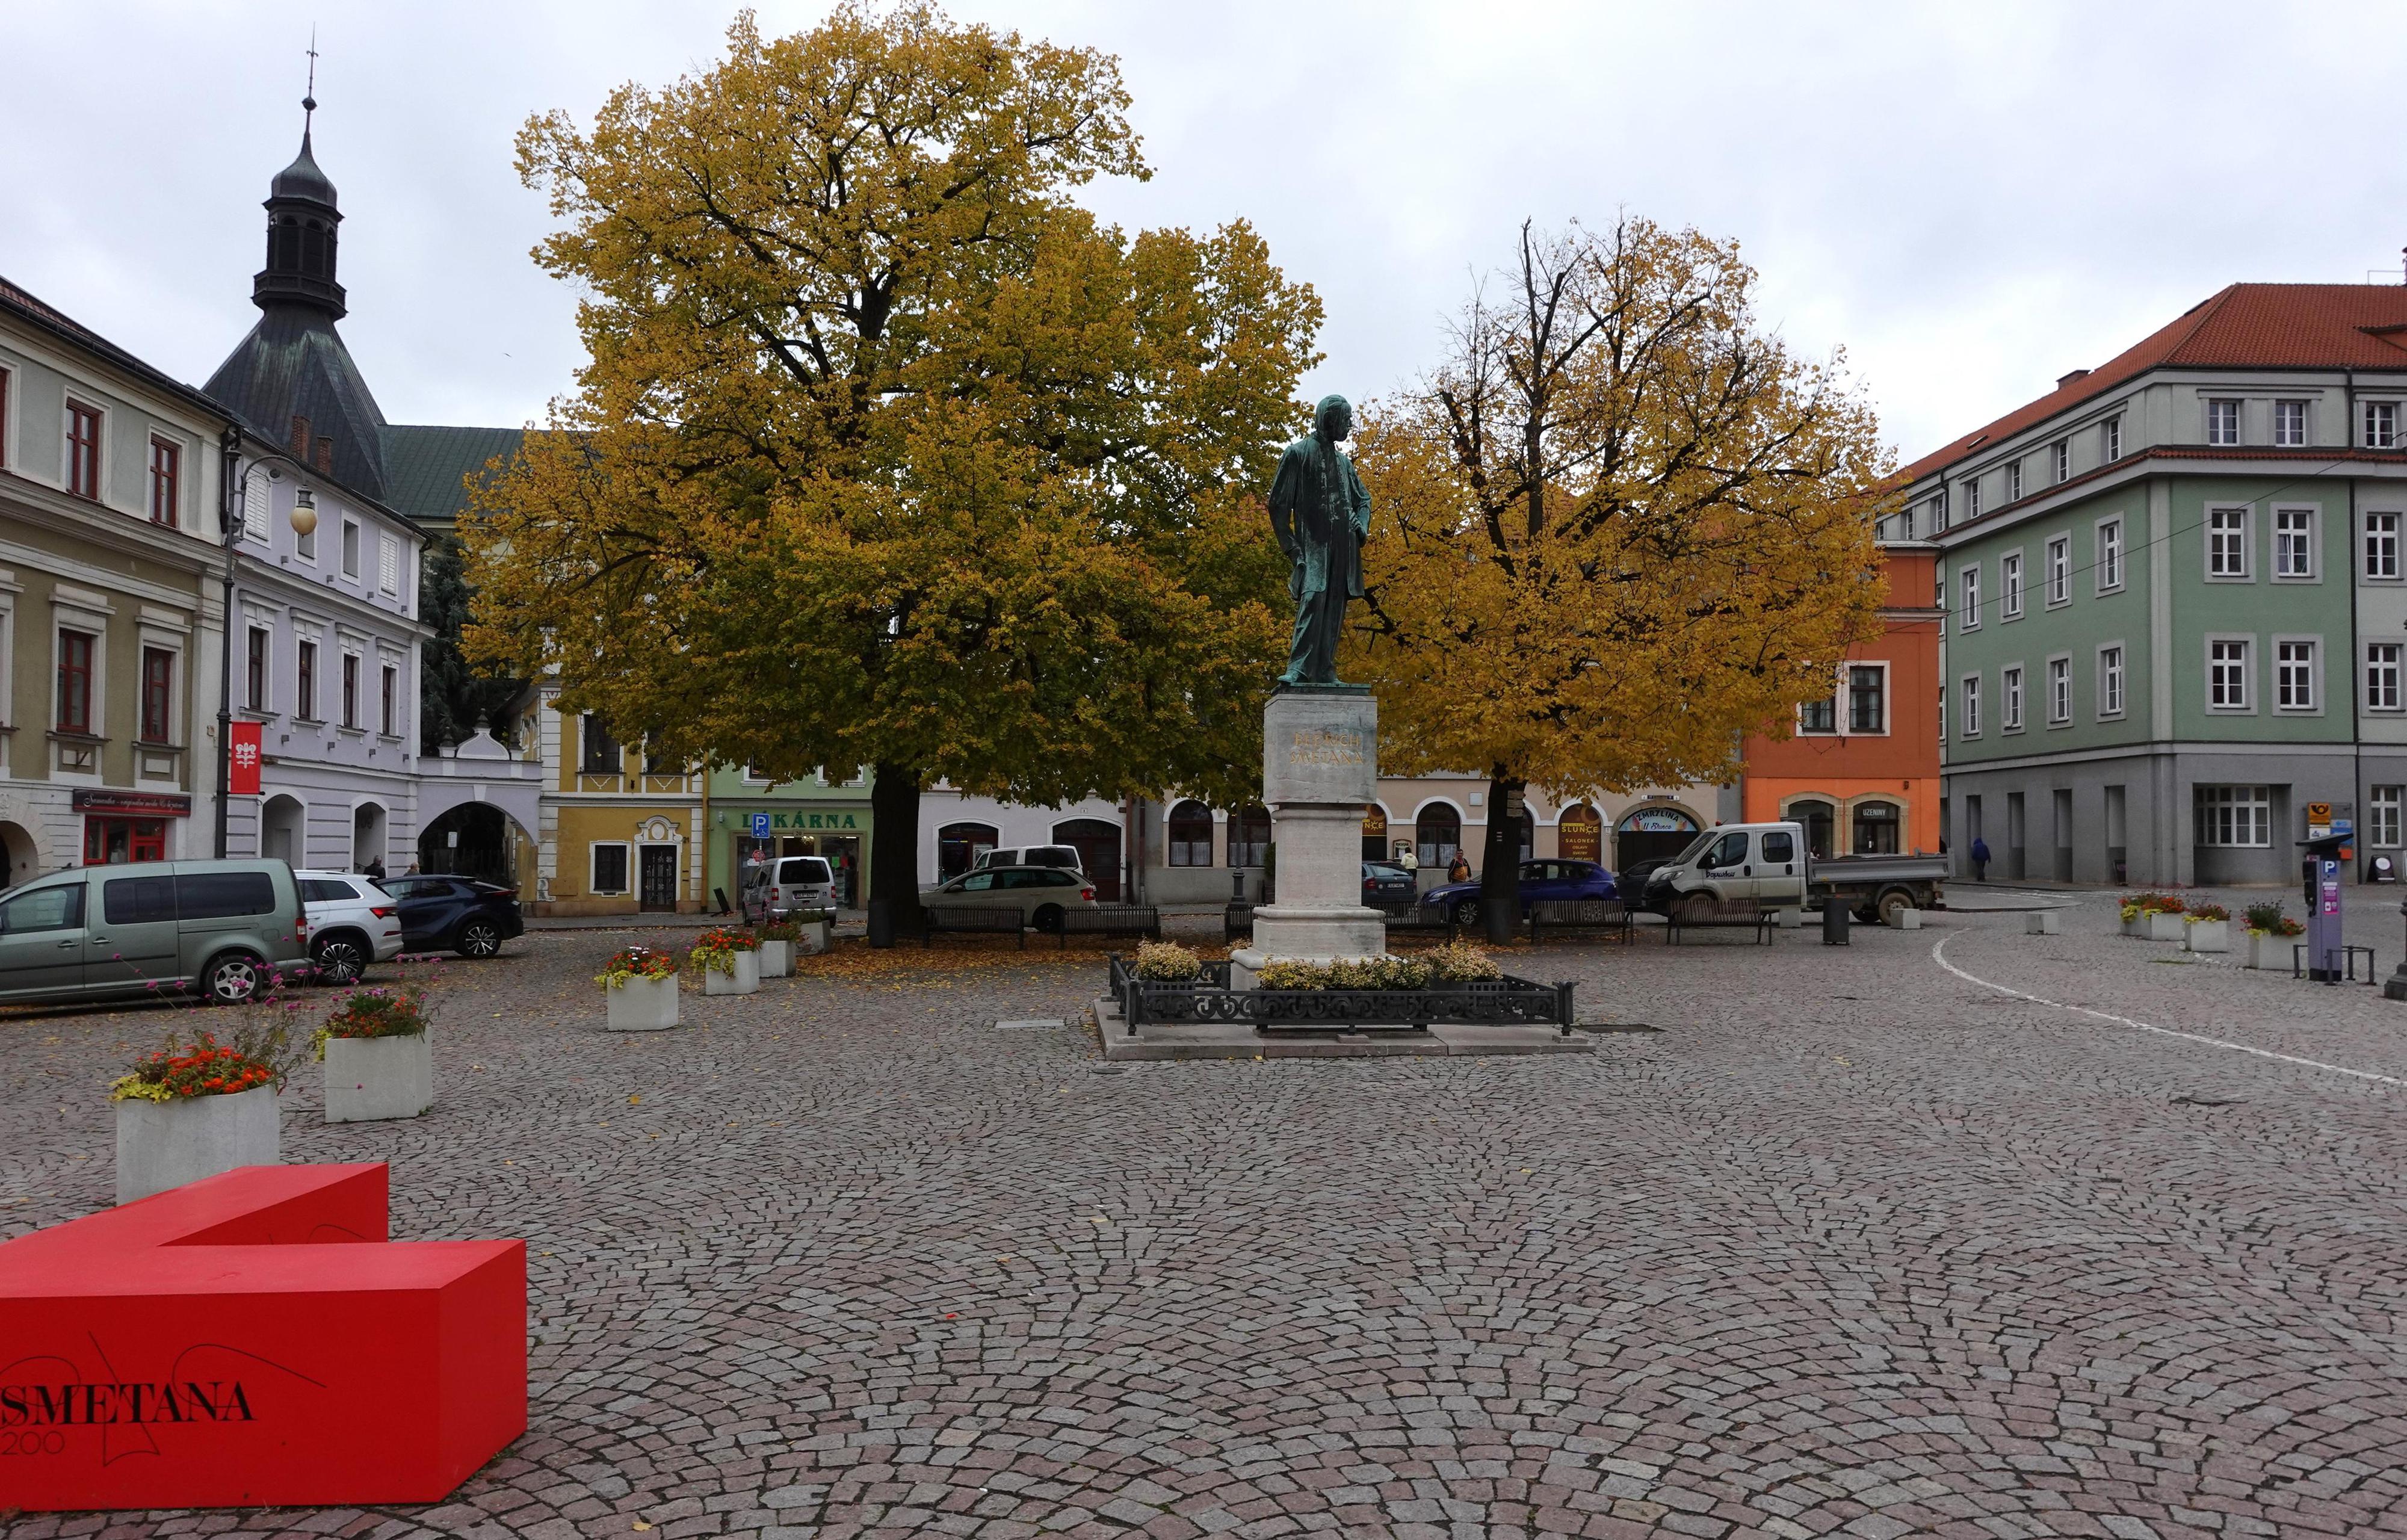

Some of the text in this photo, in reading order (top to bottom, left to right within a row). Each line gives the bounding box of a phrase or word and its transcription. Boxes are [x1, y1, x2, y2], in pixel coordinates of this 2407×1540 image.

[1290, 750, 1364, 765] SMETANA
[742, 810, 856, 828] LKÁRNA
[756, 817, 766, 830] P
[2325, 861, 2335, 873] P
[0, 1381, 258, 1426] SMETANA
[1, 1430, 65, 1455] 200
